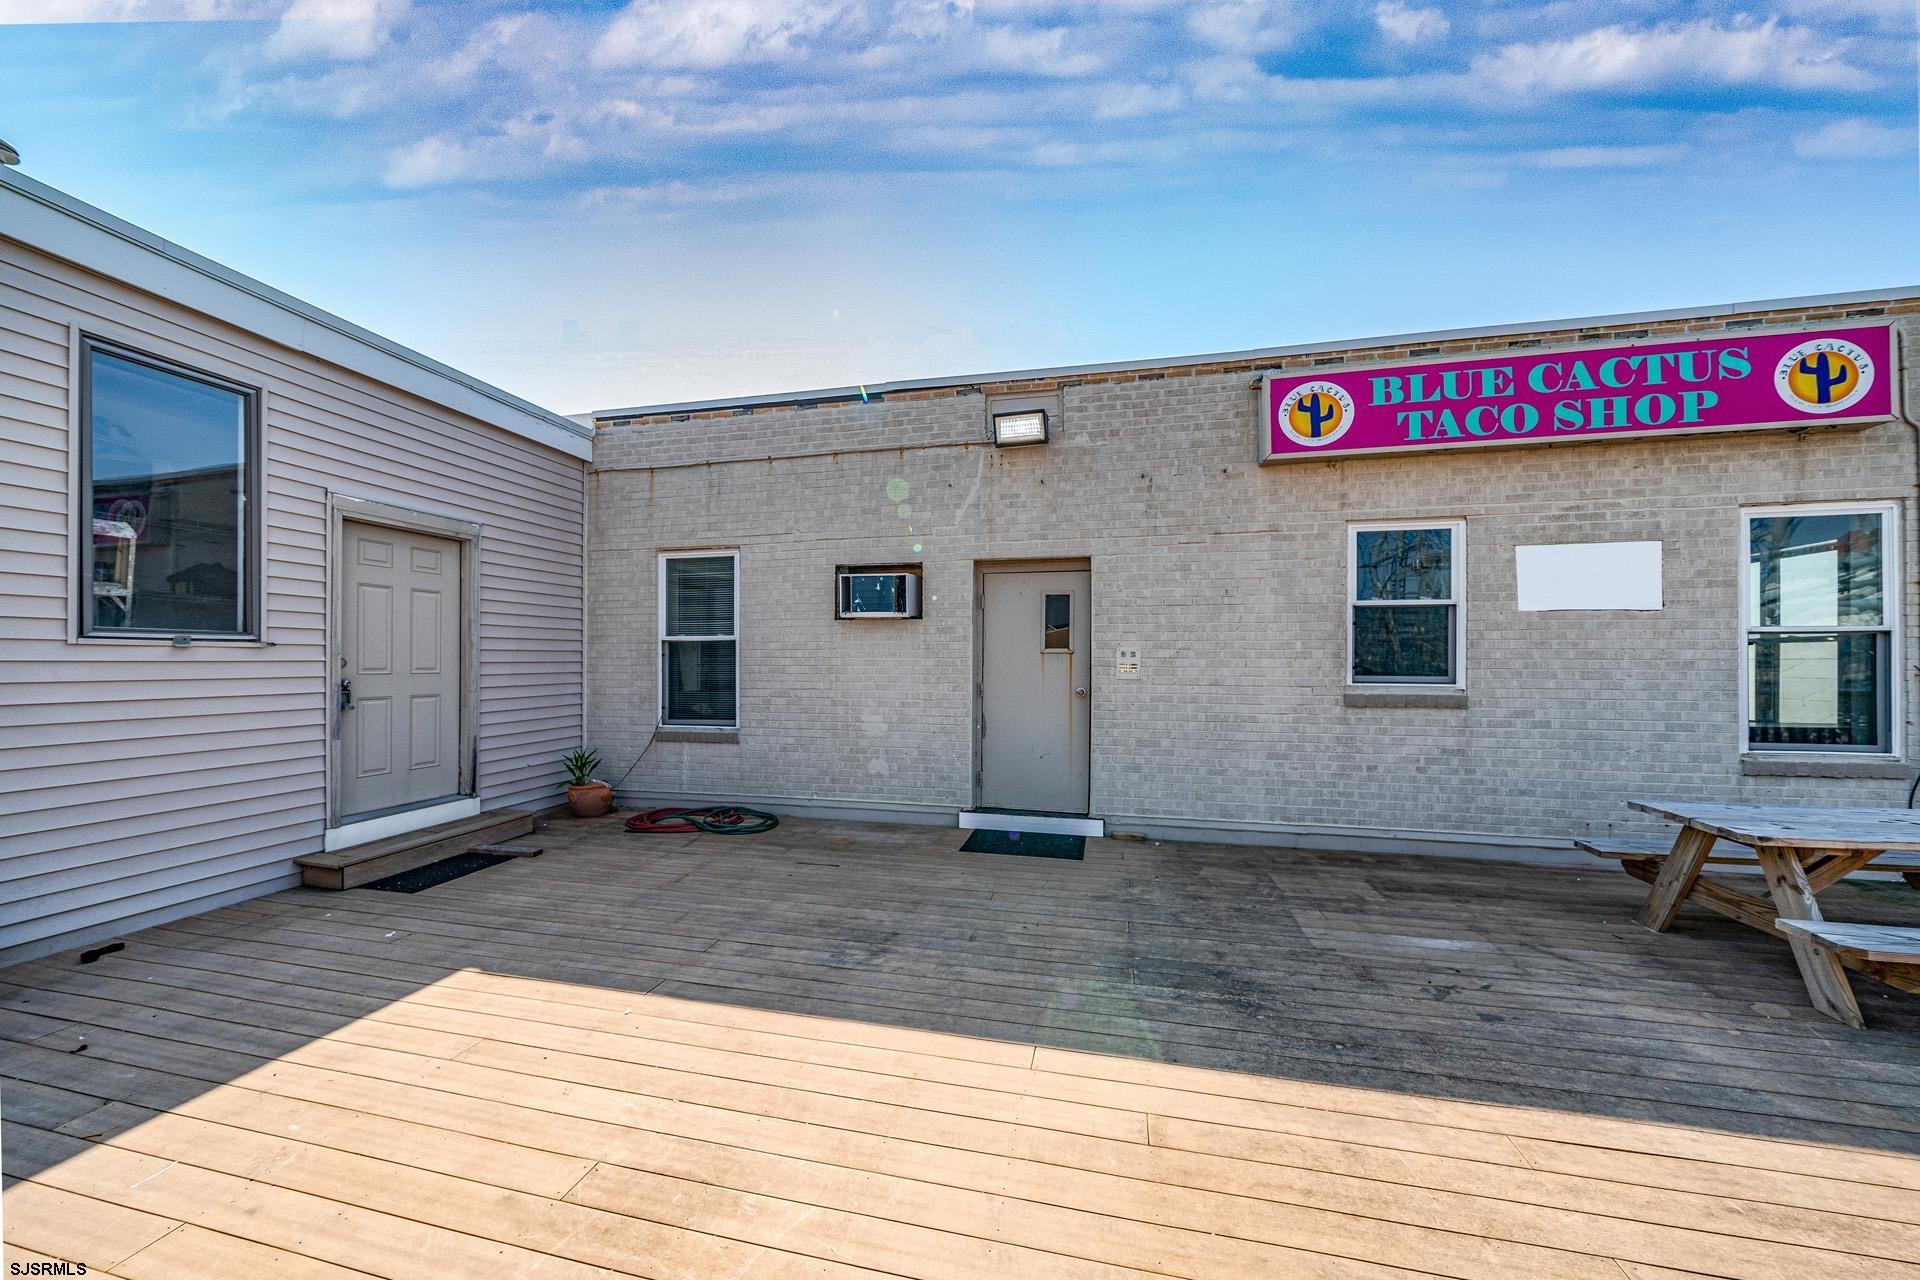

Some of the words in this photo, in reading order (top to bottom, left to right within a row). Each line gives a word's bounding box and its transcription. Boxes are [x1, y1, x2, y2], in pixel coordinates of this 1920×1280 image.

[1368, 366, 1514, 406] BLUE
[1528, 347, 1752, 394] CACTUS
[1397, 403, 1539, 441] TACO
[1553, 390, 1719, 432] SHOP
